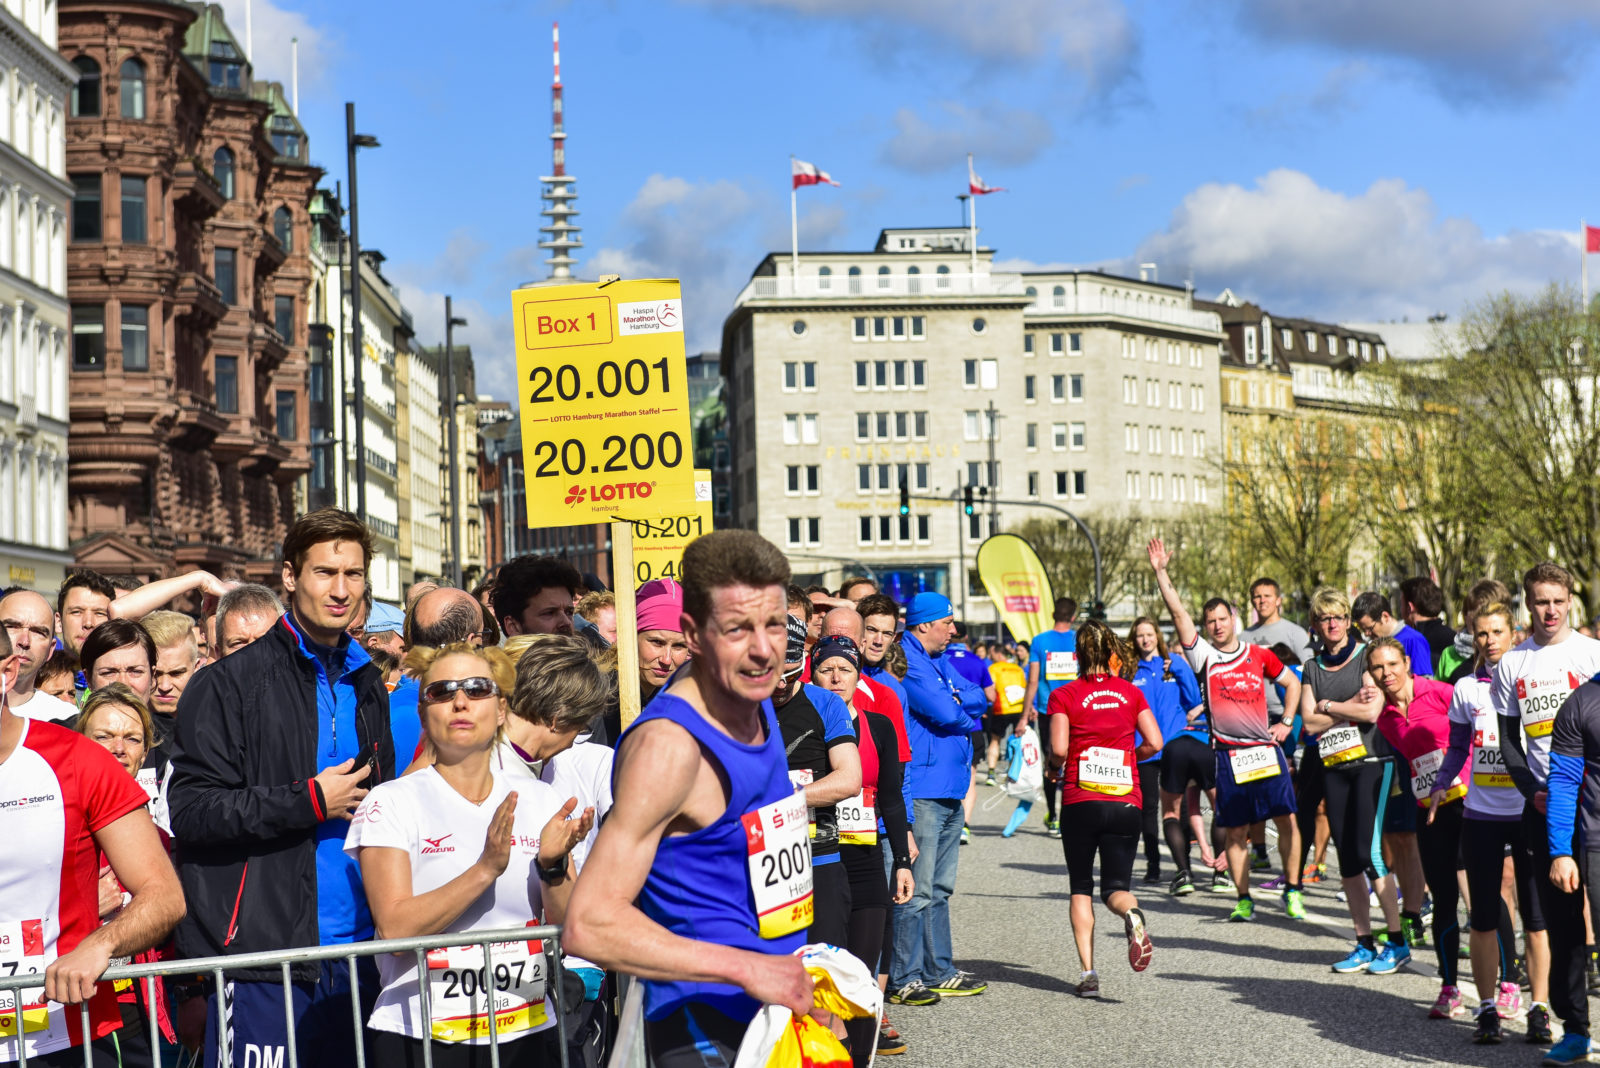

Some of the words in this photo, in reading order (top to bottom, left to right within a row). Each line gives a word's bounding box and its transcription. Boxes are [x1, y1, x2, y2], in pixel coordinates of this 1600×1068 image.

[633, 307, 654, 315] Haspa
[537, 315, 580, 335] Box
[586, 312, 596, 331] 1
[623, 315, 656, 324] Marathon
[629, 322, 660, 331] Hamburg
[529, 357, 670, 404] 20.001
[550, 415, 571, 423] LOTTO
[572, 412, 604, 421] Hamburg
[604, 410, 637, 419] Marathon
[638, 407, 661, 416] Staffel
[534, 431, 683, 478] 20.200
[590, 481, 653, 502] LOTTO
[591, 504, 620, 513] Hamburg
[631, 515, 703, 539] 0.201
[1086, 763, 1128, 779] STAFFEL
[29, 793, 55, 803] steria
[442, 960, 526, 999] 20097
[533, 964, 541, 978] 2
[482, 1016, 516, 1030] LTTO
[244, 1043, 285, 1068] DM
